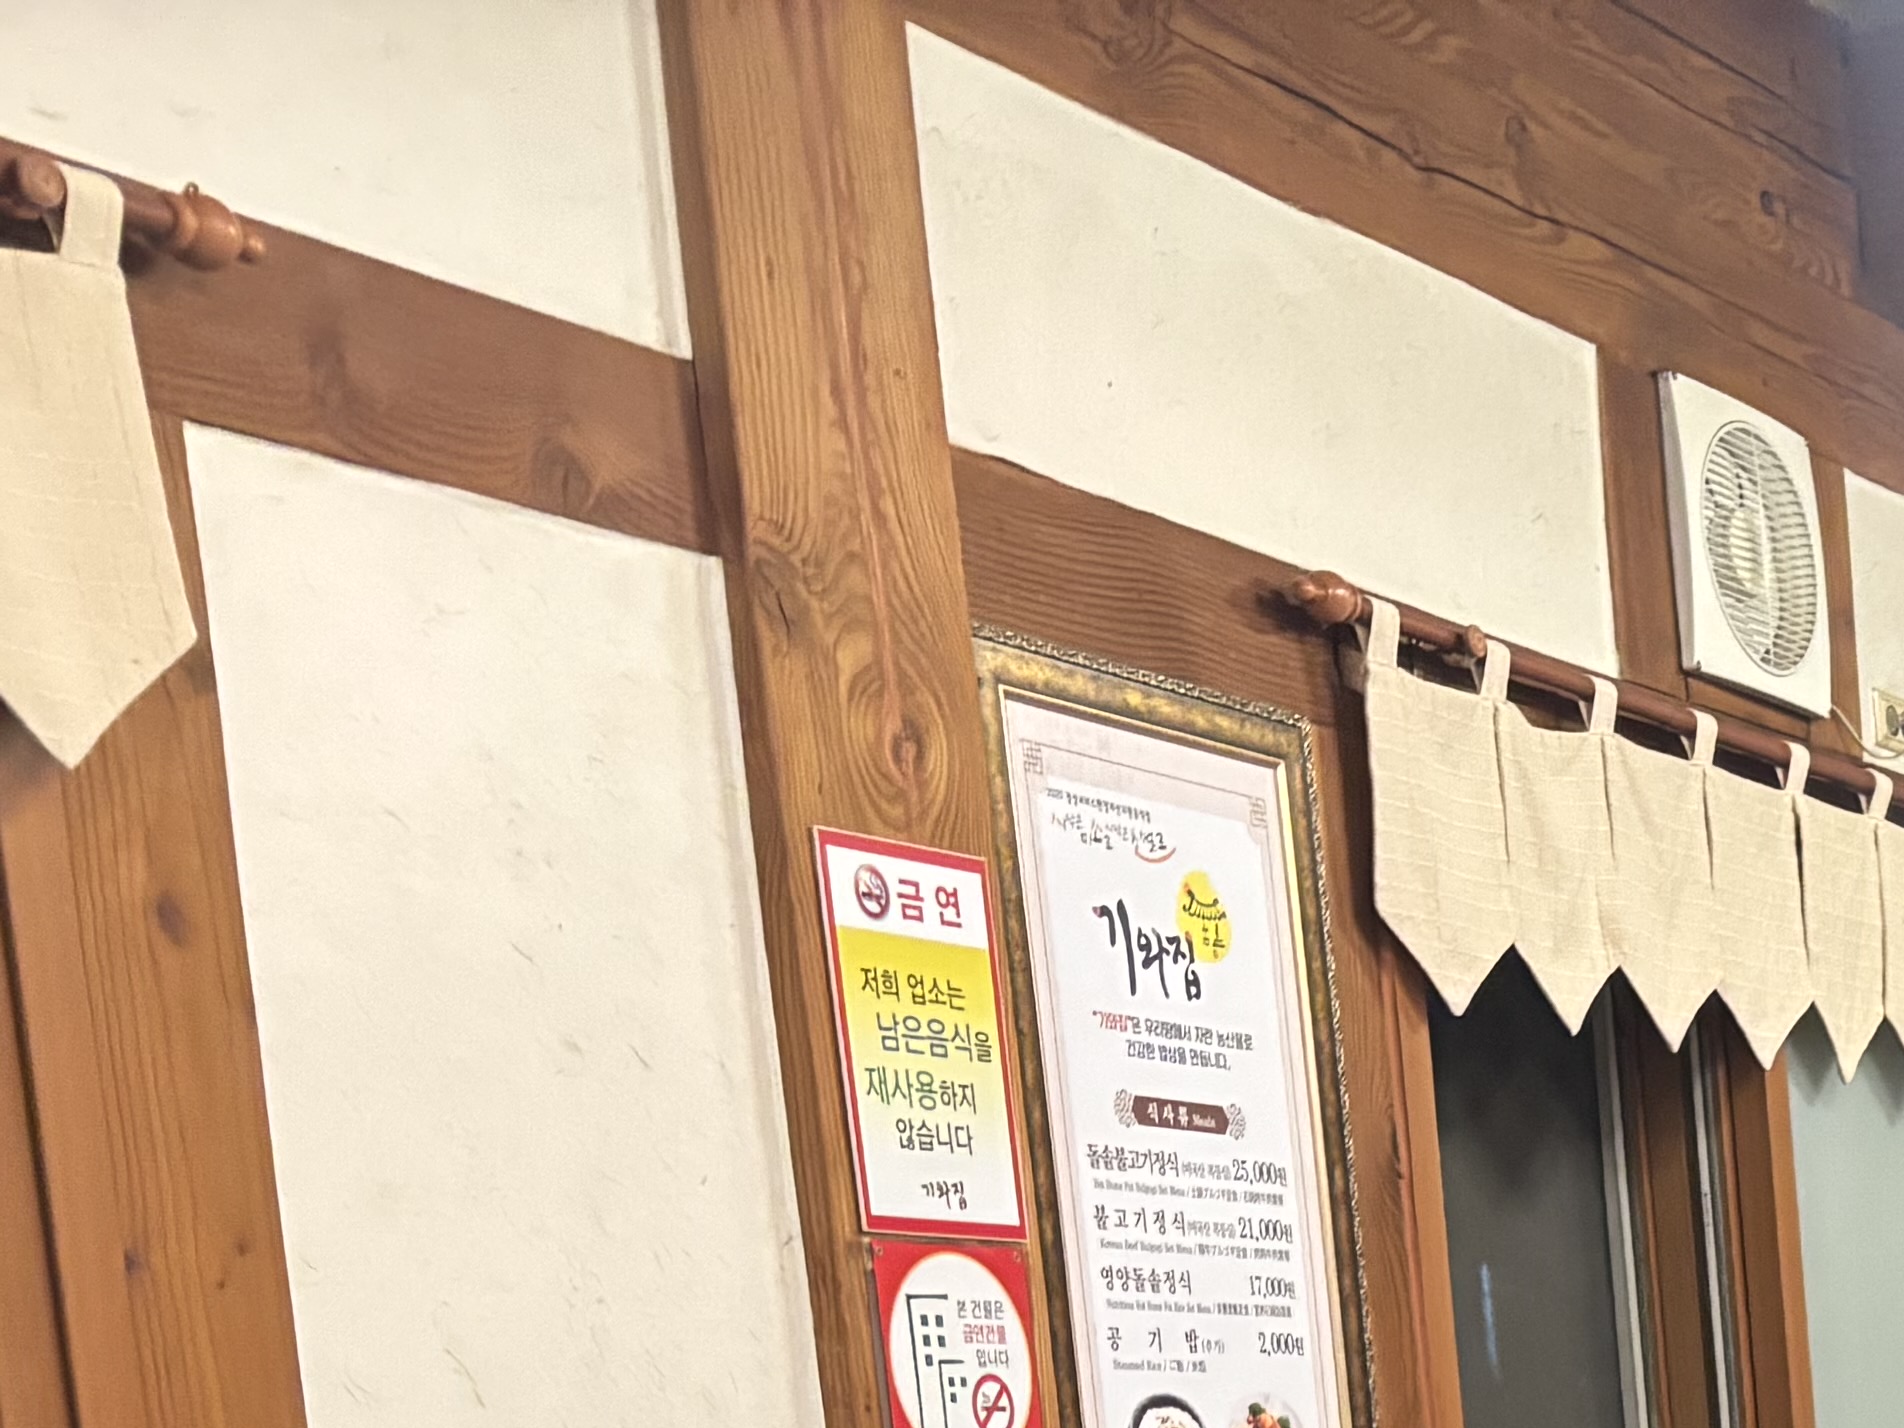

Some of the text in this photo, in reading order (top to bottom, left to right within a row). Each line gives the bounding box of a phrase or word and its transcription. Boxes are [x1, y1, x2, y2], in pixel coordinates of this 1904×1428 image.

[896, 877, 963, 929] 금연
[1092, 898, 1202, 1002] 기와집
[860, 966, 966, 1011] 저희 업소는
[876, 1012, 993, 1063] 남은음식을
[864, 1066, 977, 1115] 재사용하지
[895, 1118, 974, 1156] 않습니다
[1087, 1143, 1179, 1178] 돌솥불고기정식
[1232, 1158, 1288, 1187] 25,000원
[921, 1180, 968, 1210] 기와집
[1238, 1216, 1293, 1244] 21,000원
[1100, 1264, 1296, 1300] 영양돌솥정식 17,000원
[976, 1348, 1009, 1369] 입니다
[1258, 1331, 1305, 1357] 2,000원
